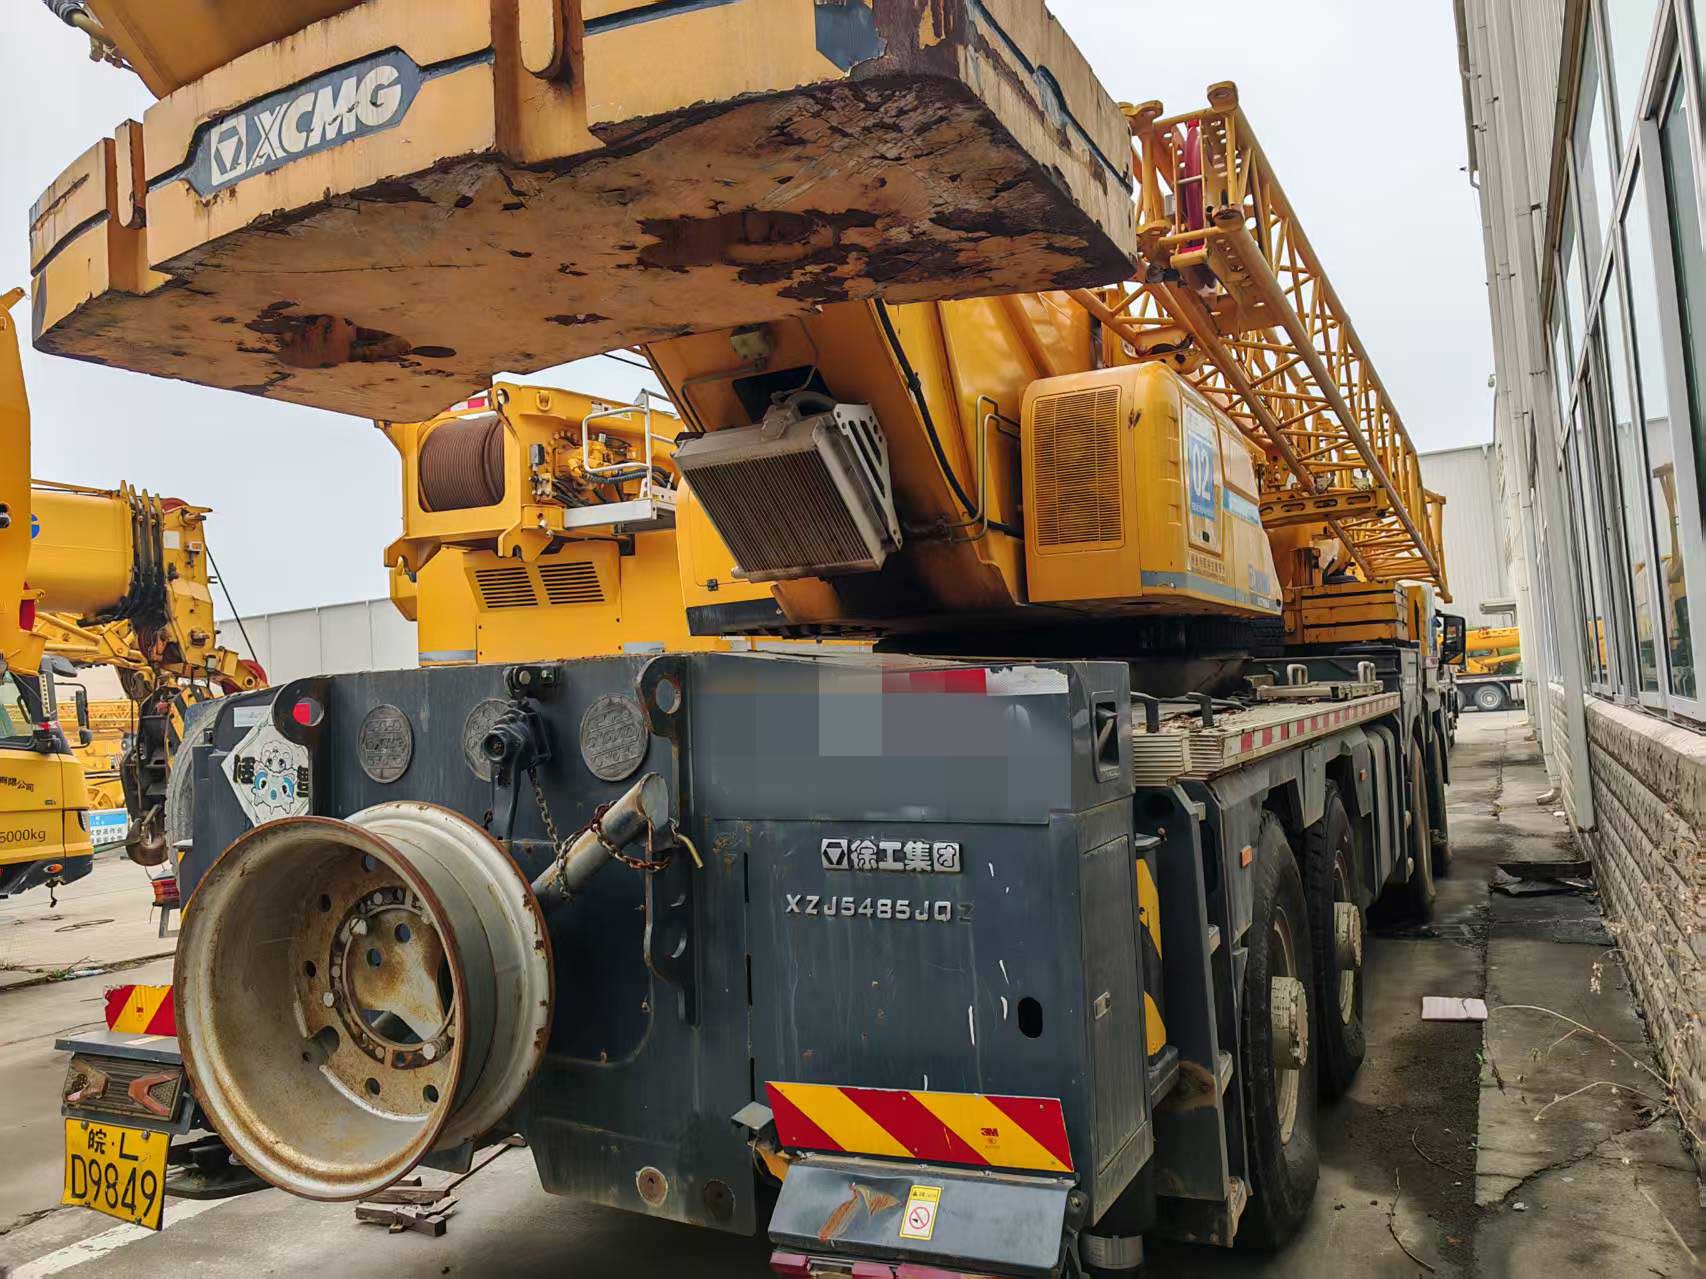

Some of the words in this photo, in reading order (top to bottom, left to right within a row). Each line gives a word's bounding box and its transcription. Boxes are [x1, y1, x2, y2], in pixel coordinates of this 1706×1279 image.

[247, 65, 401, 170] XCMG
[1193, 444, 1212, 501] 02
[851, 839, 961, 872] 徐工集团
[71, 1153, 157, 1218] D9849
